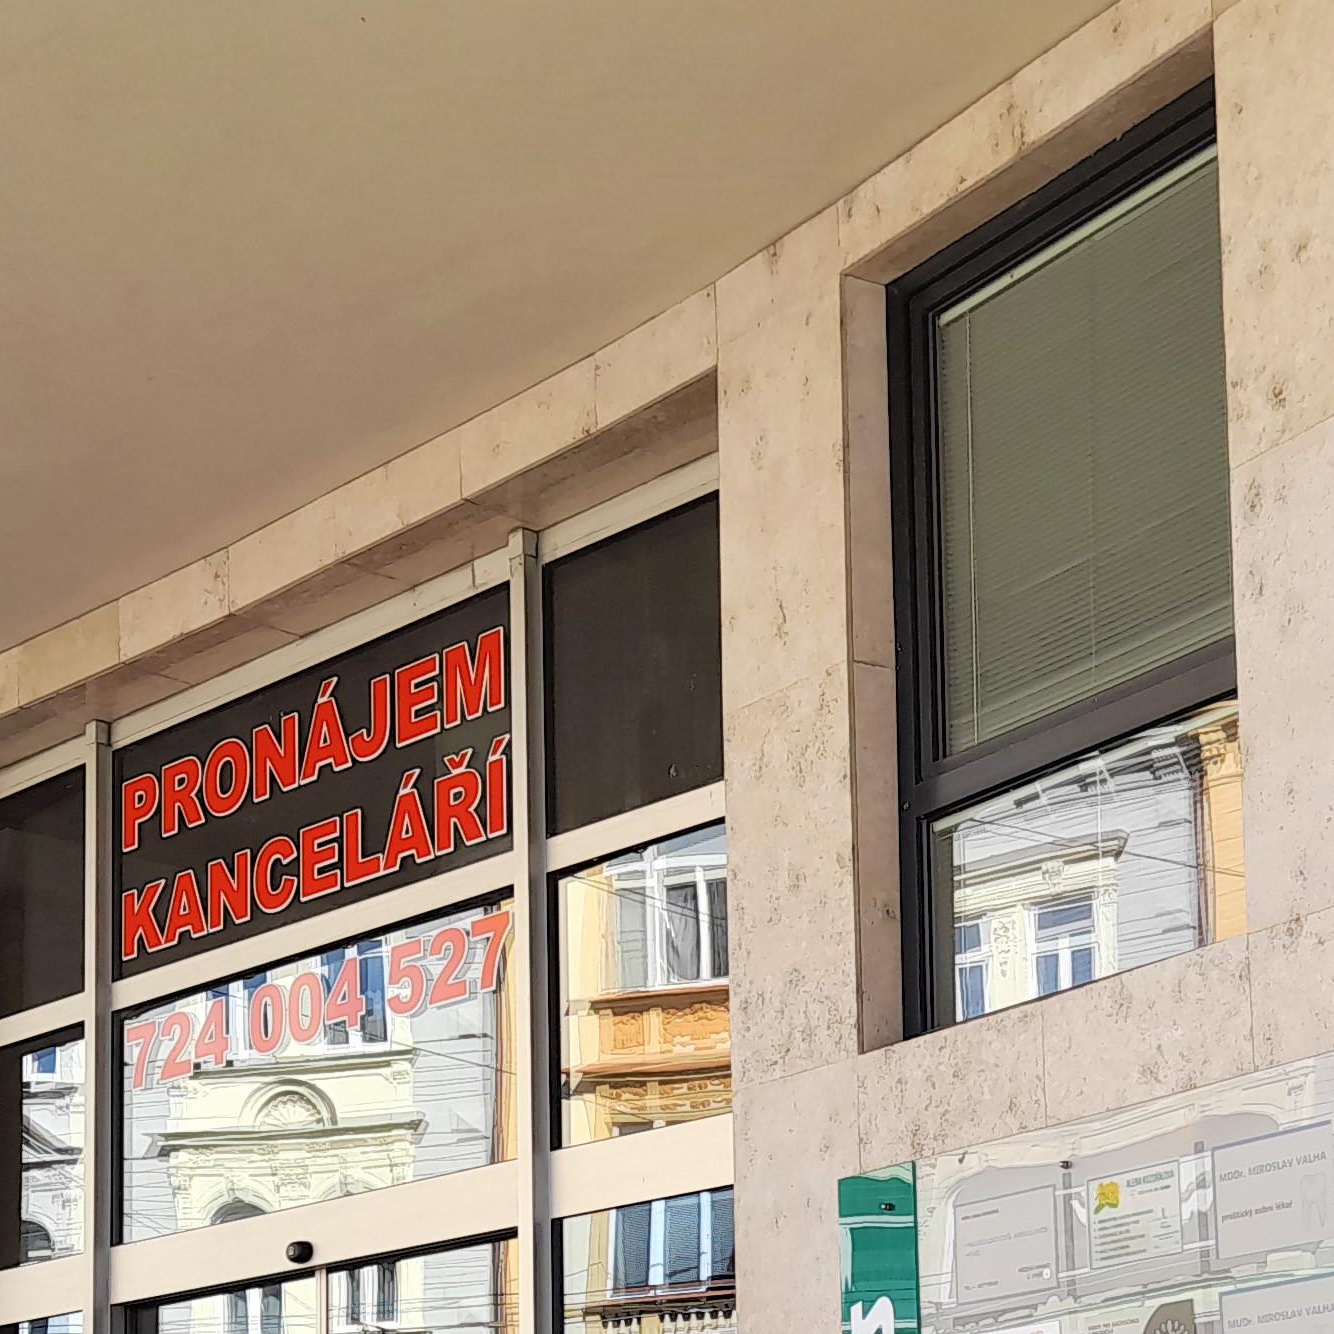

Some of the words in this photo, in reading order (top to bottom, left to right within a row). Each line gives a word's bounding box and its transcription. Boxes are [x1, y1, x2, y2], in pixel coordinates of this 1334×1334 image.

[122, 626, 508, 853] PRONÁJEM
[122, 734, 510, 961] KANCELÁŘÍ
[126, 998, 230, 1090] 724
[249, 956, 367, 1053] 004
[387, 910, 513, 1016] 527
[1248, 1159, 1294, 1176] MIROSLAV
[1296, 1151, 1327, 1167] VALHA
[1257, 1309, 1303, 1325] MIROSLAV
